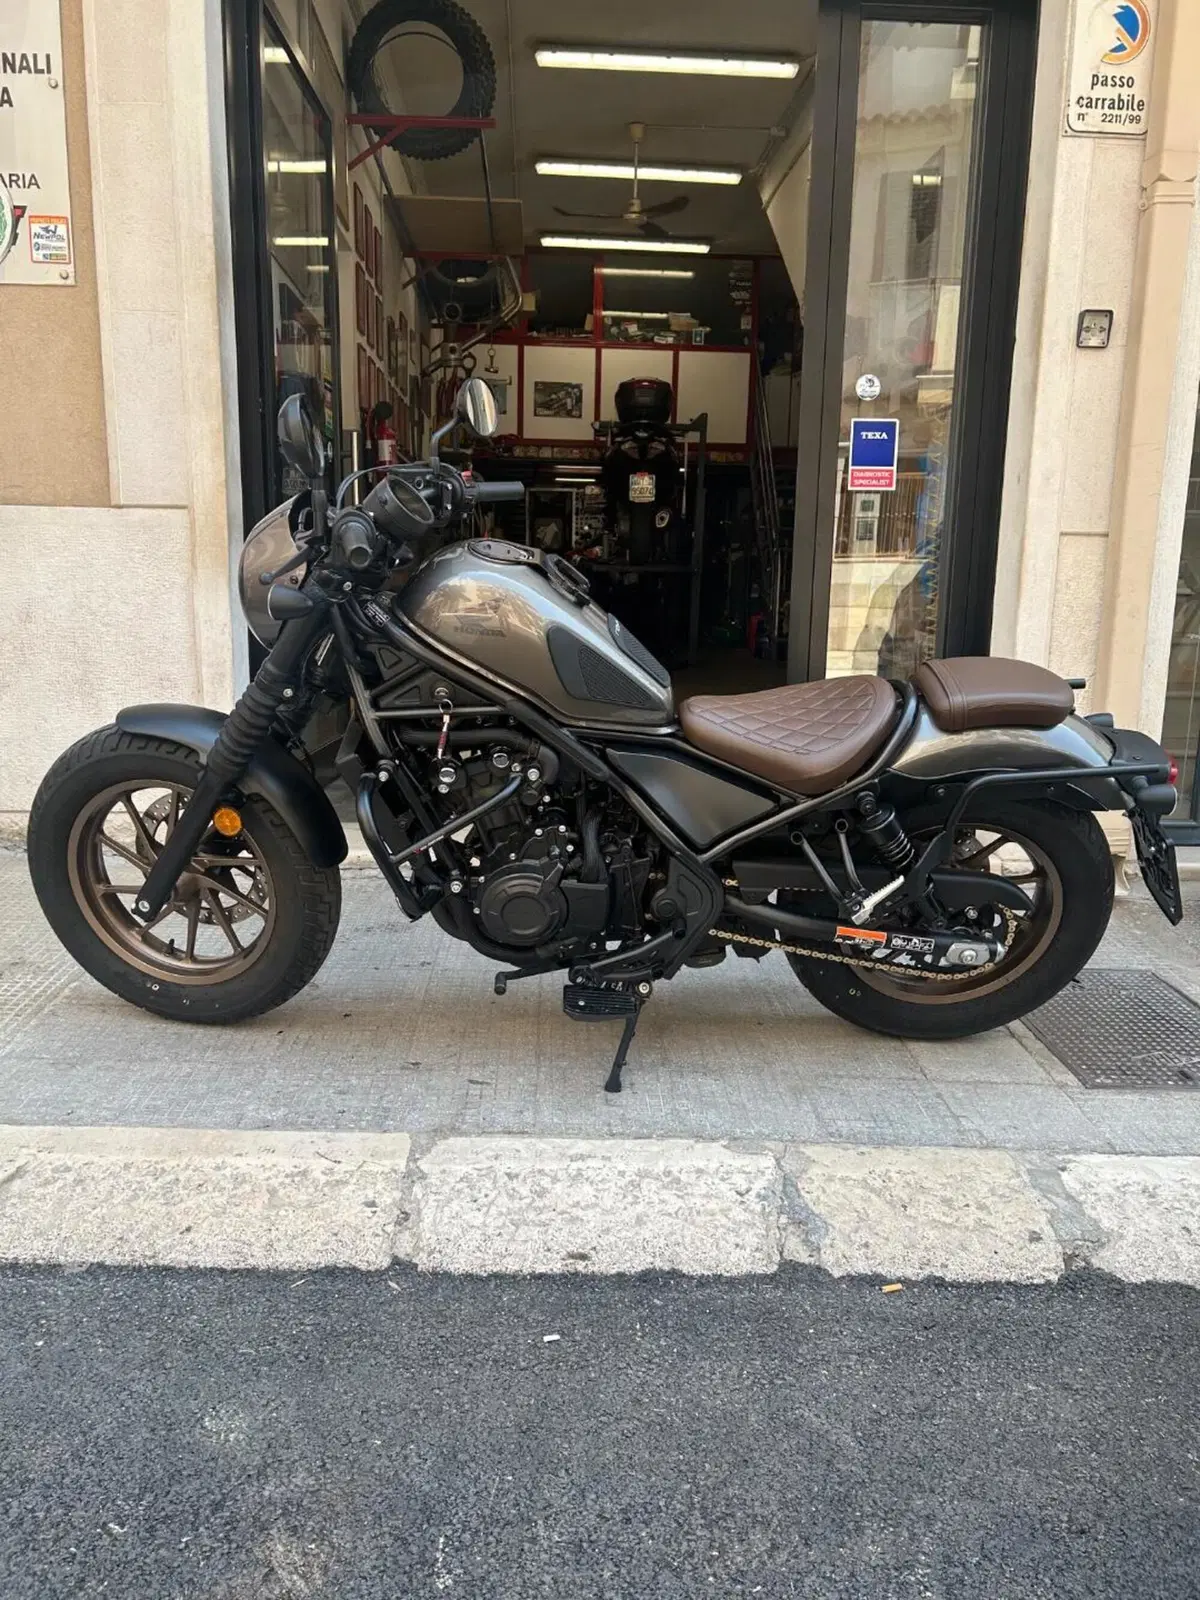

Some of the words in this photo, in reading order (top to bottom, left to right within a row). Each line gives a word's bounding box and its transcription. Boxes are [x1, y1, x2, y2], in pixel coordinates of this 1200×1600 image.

[2, 52, 51, 75] NALI
[1091, 73, 1134, 90] passo
[1076, 93, 1145, 111] carrabile
[1101, 113, 1141, 126] 2211/99
[861, 431, 888, 440] TEXA
